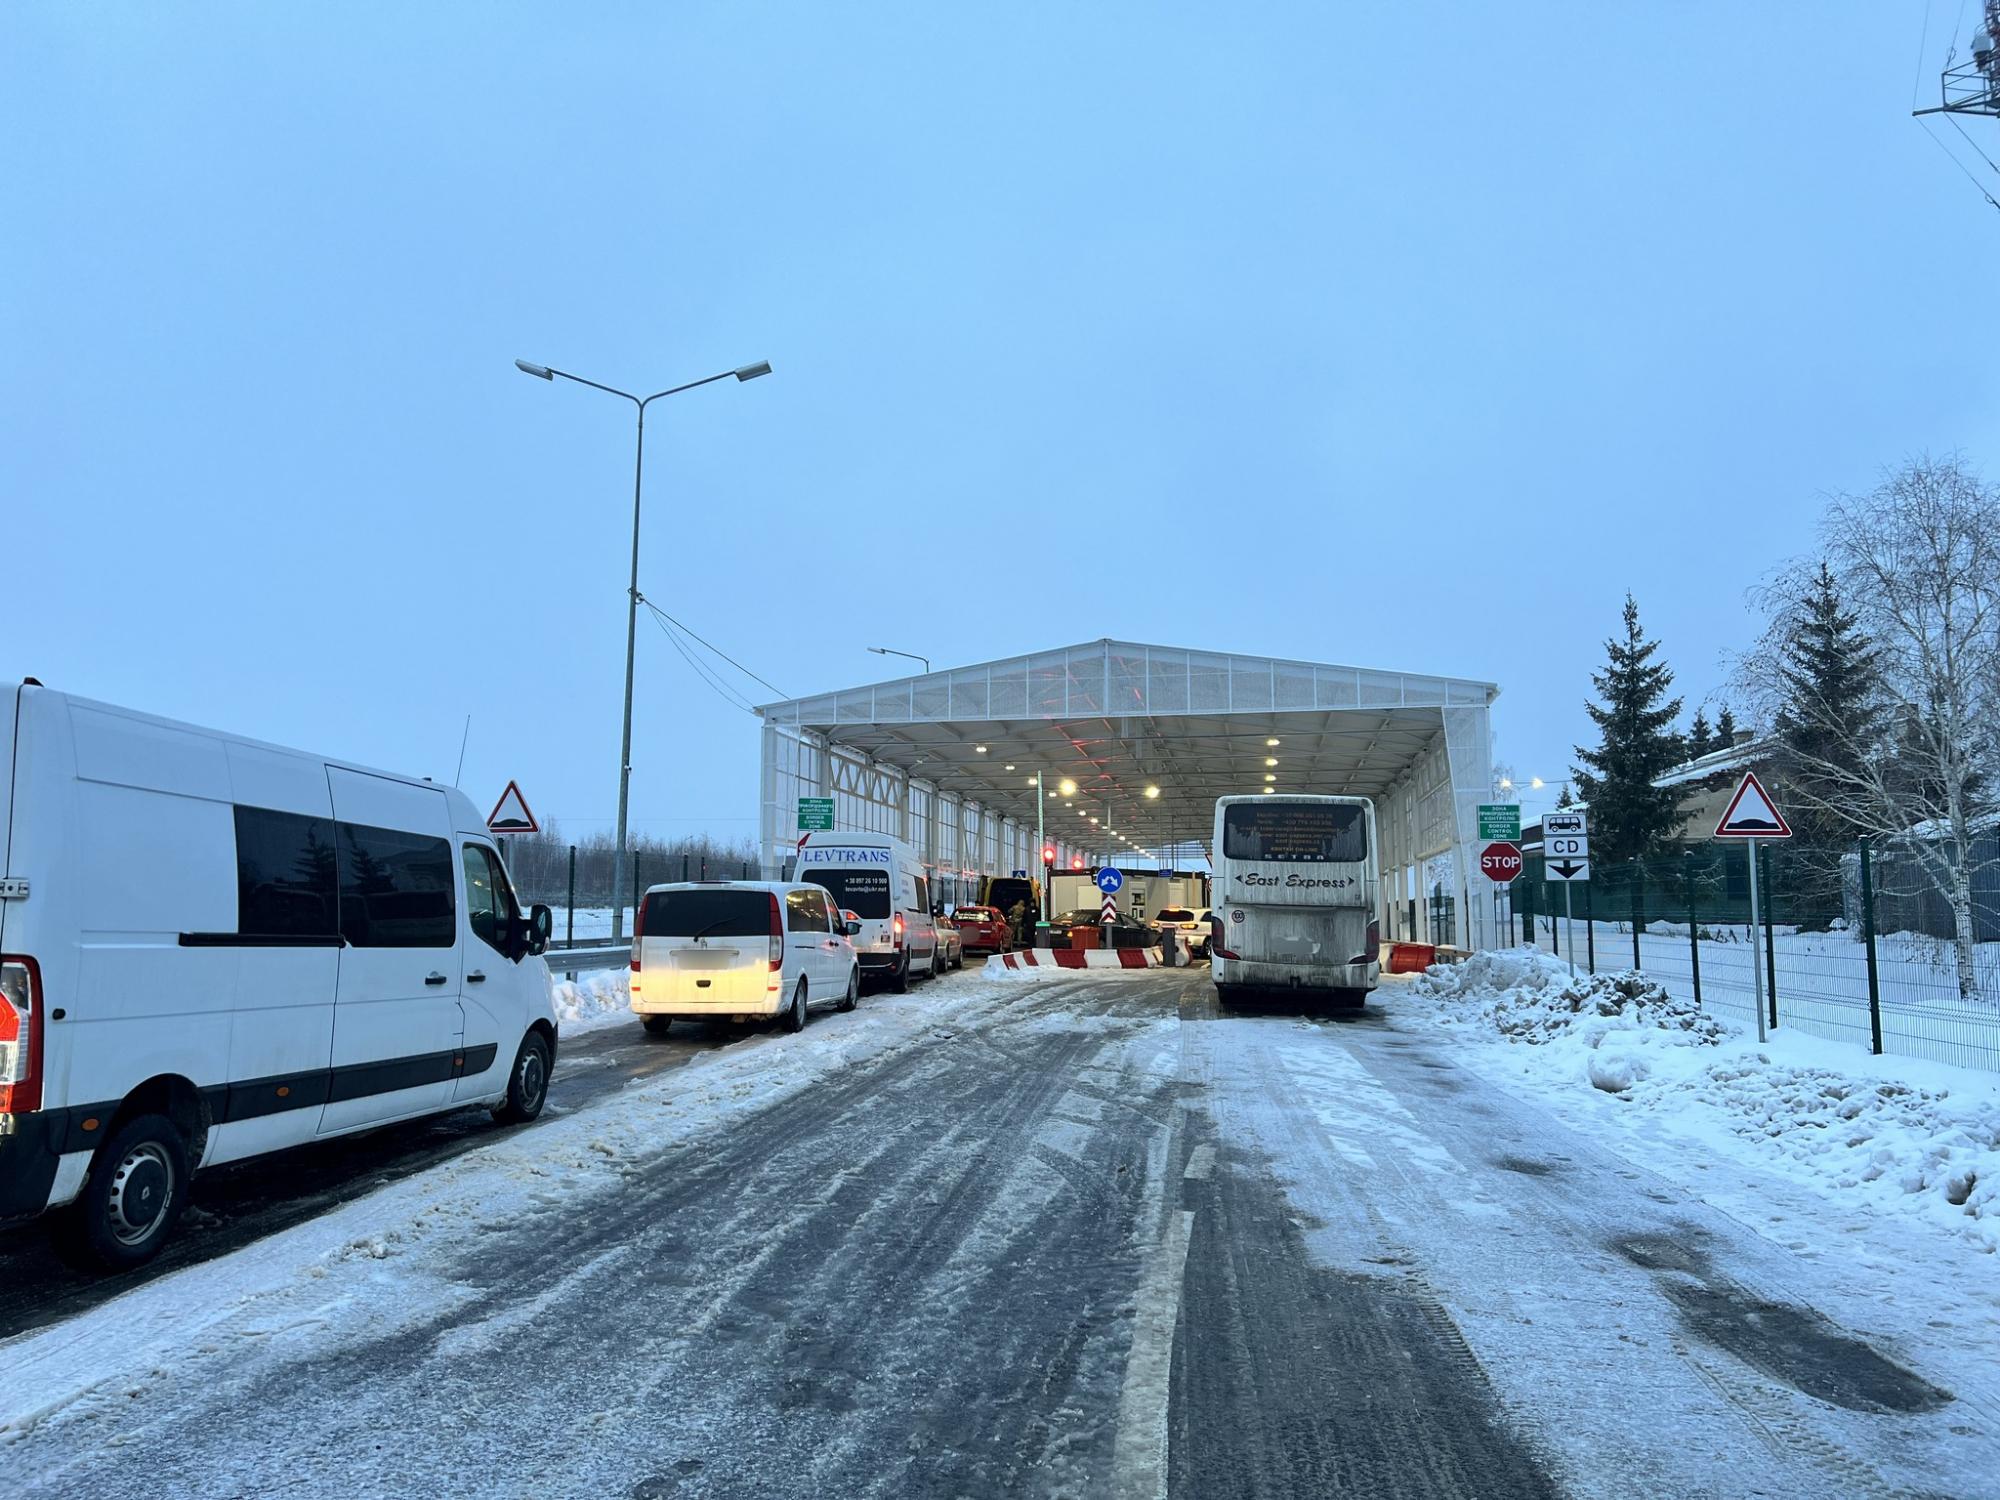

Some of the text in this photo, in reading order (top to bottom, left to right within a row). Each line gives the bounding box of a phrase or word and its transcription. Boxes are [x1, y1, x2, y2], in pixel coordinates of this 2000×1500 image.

[1553, 840, 1579, 854] CD
[804, 850, 889, 862] LEVTRANS
[1482, 856, 1520, 869] STOP
[1245, 872, 1346, 889] East Express
